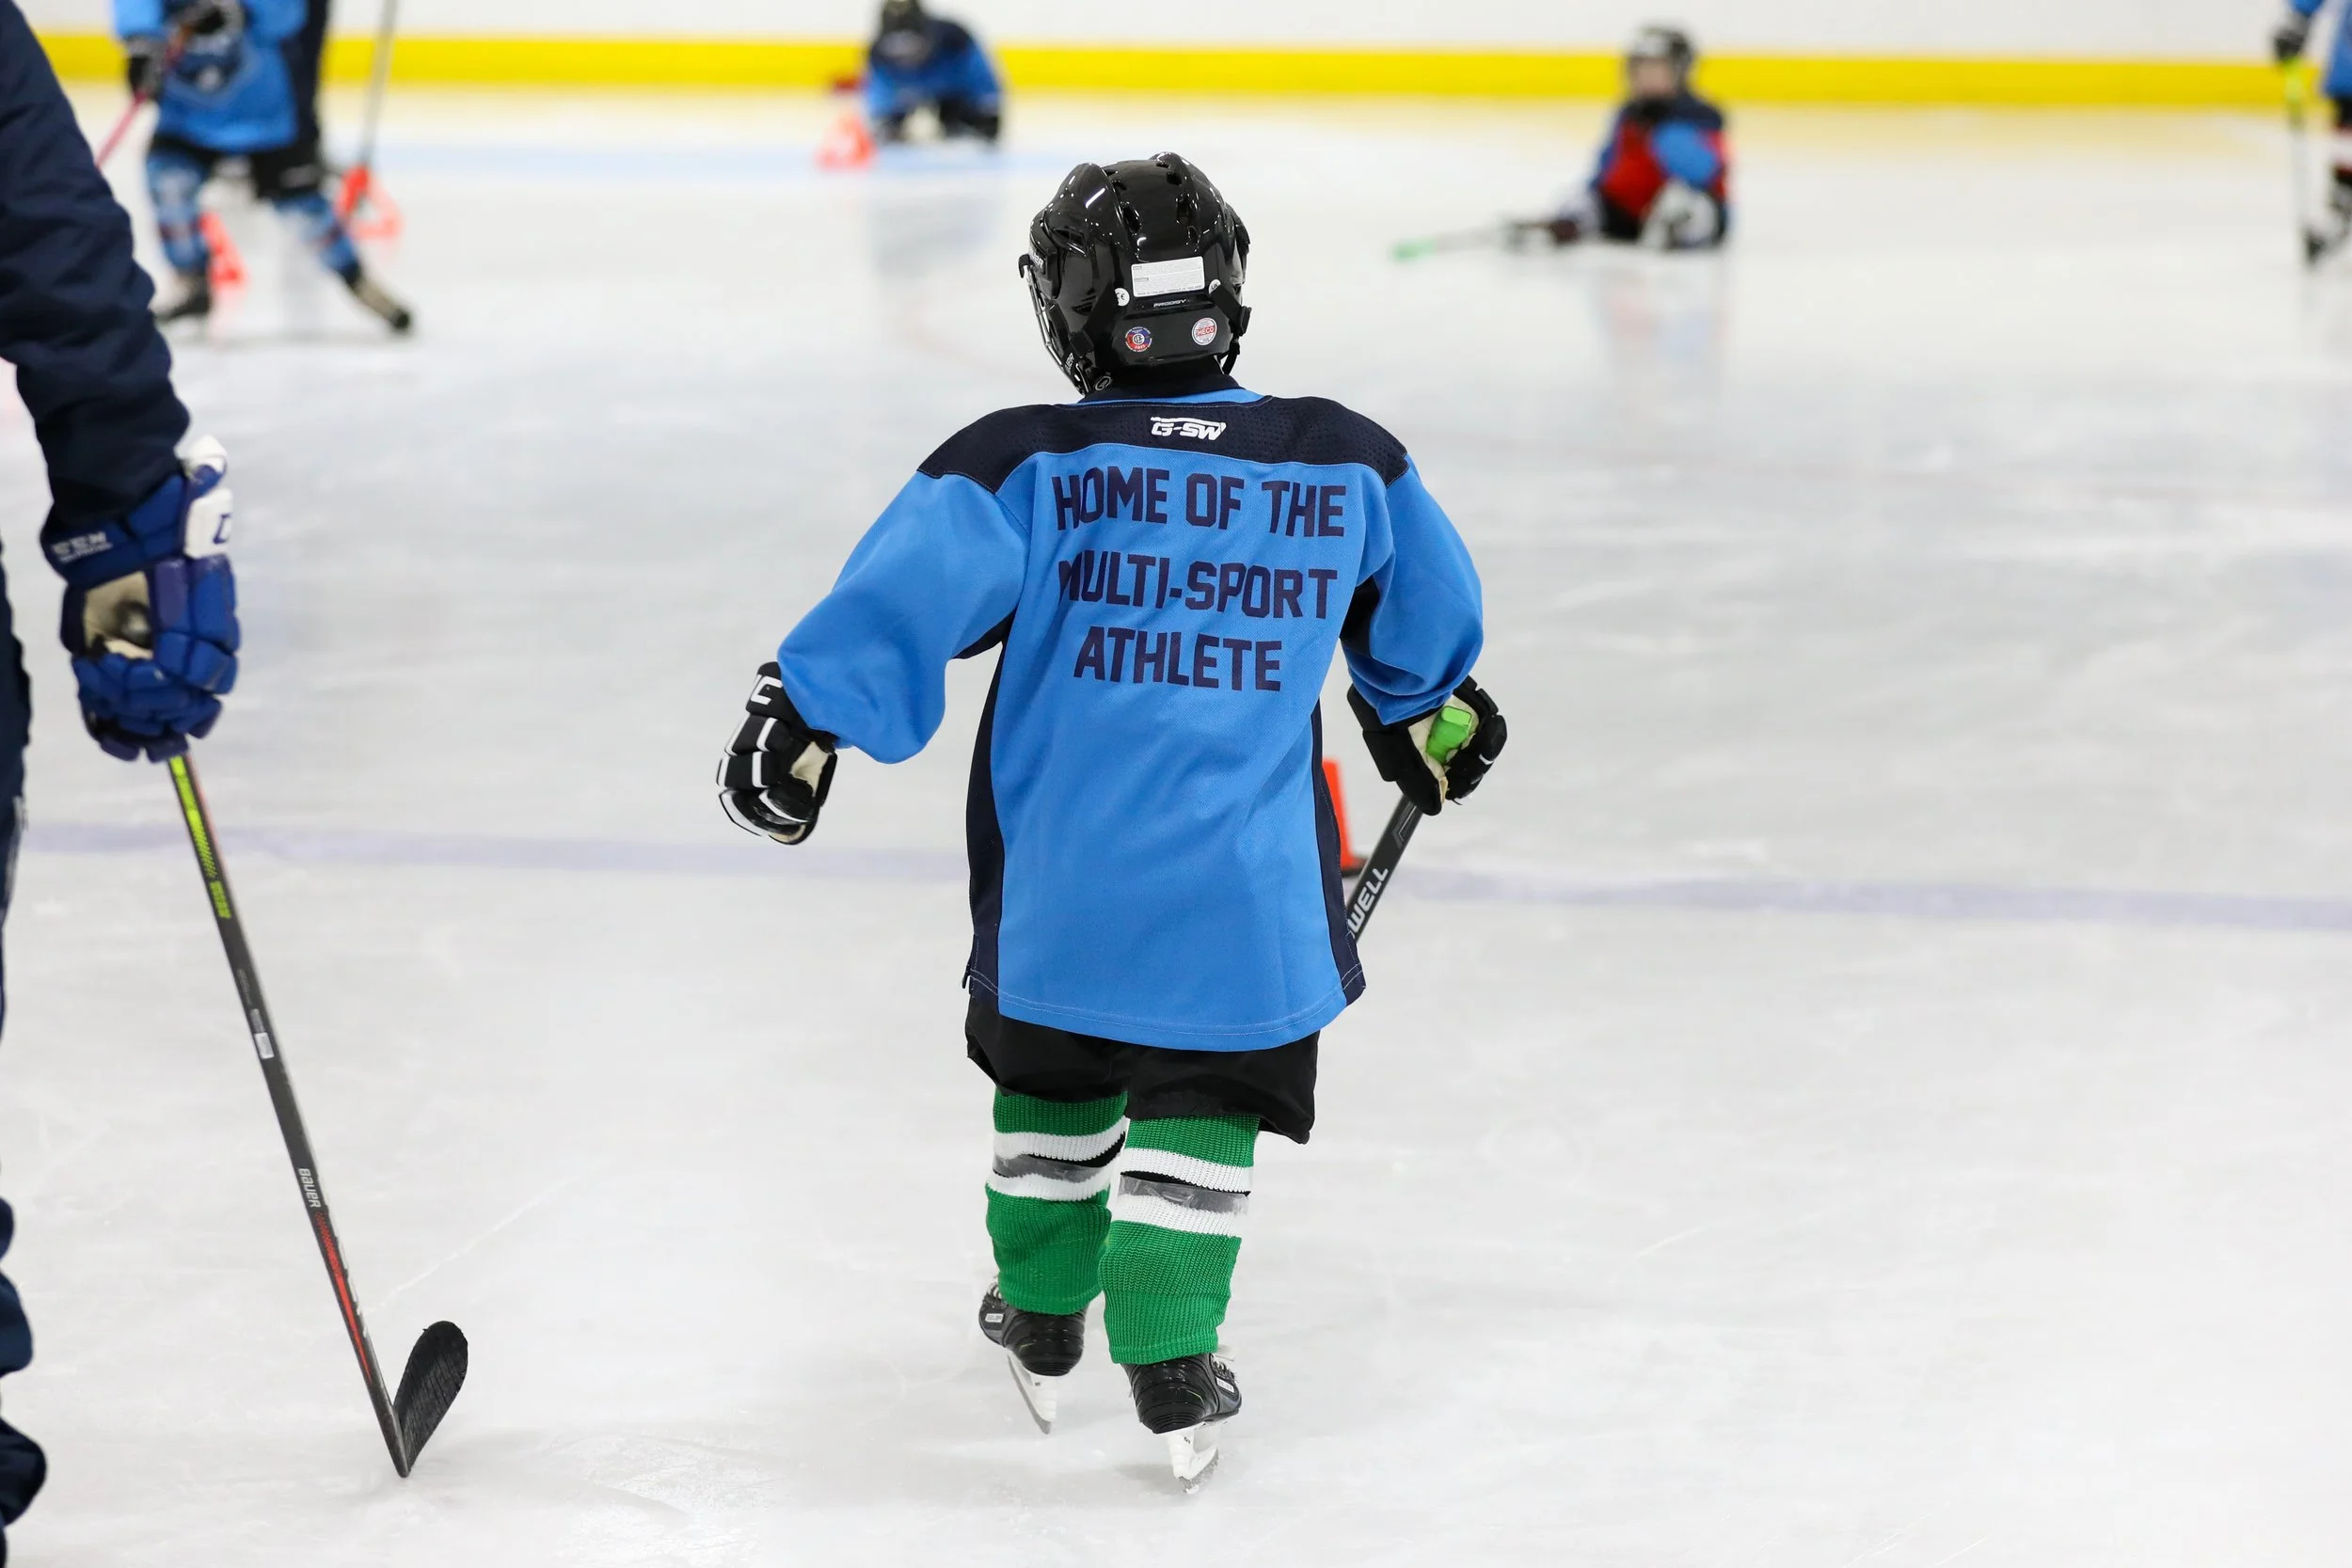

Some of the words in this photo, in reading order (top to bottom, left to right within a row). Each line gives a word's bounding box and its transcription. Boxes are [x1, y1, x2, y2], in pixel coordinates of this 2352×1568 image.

[1052, 466, 1169, 531] HOME
[1185, 473, 1245, 531] OF
[1261, 481, 1346, 537] THE
[1073, 626, 1281, 691] ATHLETE
[298, 1168, 321, 1208] BAUER
